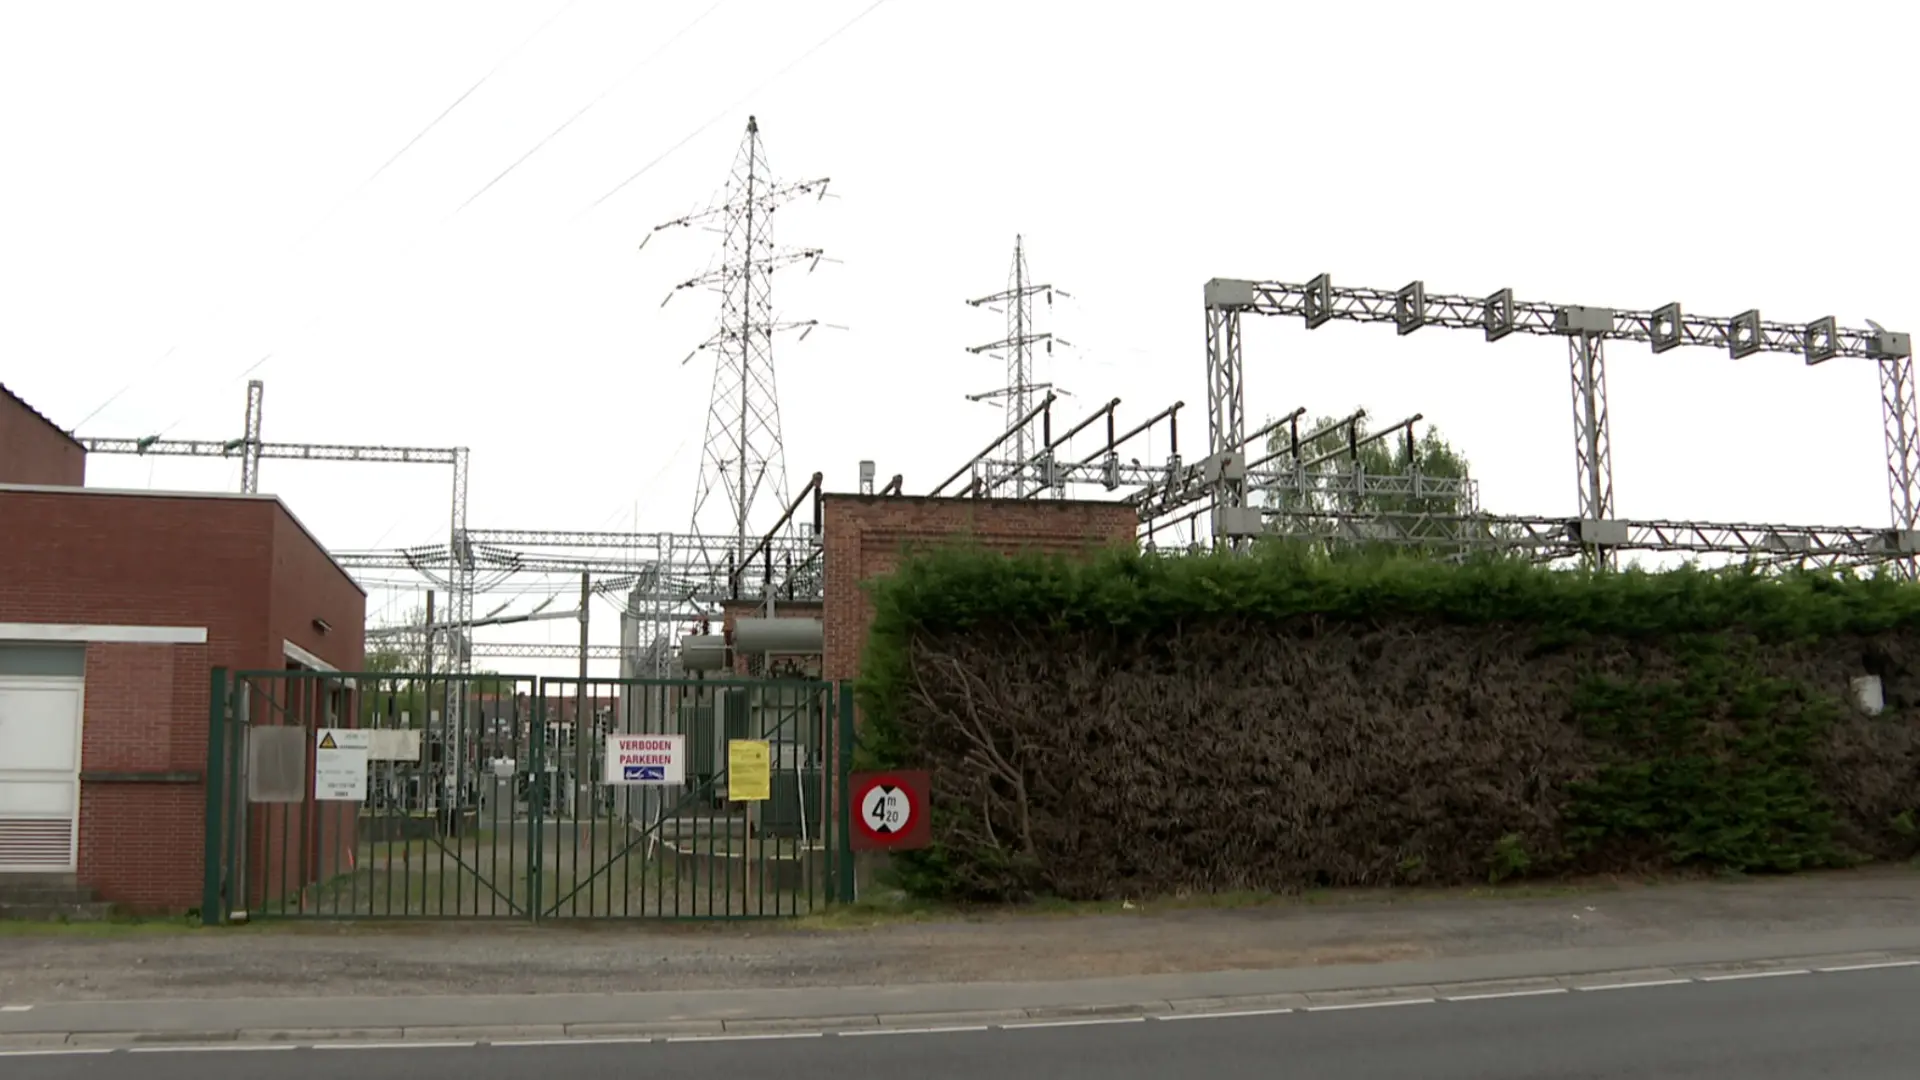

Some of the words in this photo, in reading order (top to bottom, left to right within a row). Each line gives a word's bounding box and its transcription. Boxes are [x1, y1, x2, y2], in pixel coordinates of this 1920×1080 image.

[619, 740, 672, 751] VERBODEN
[619, 754, 672, 765] PARKEREN
[872, 796, 886, 821] 4
[886, 810, 899, 823] 20
